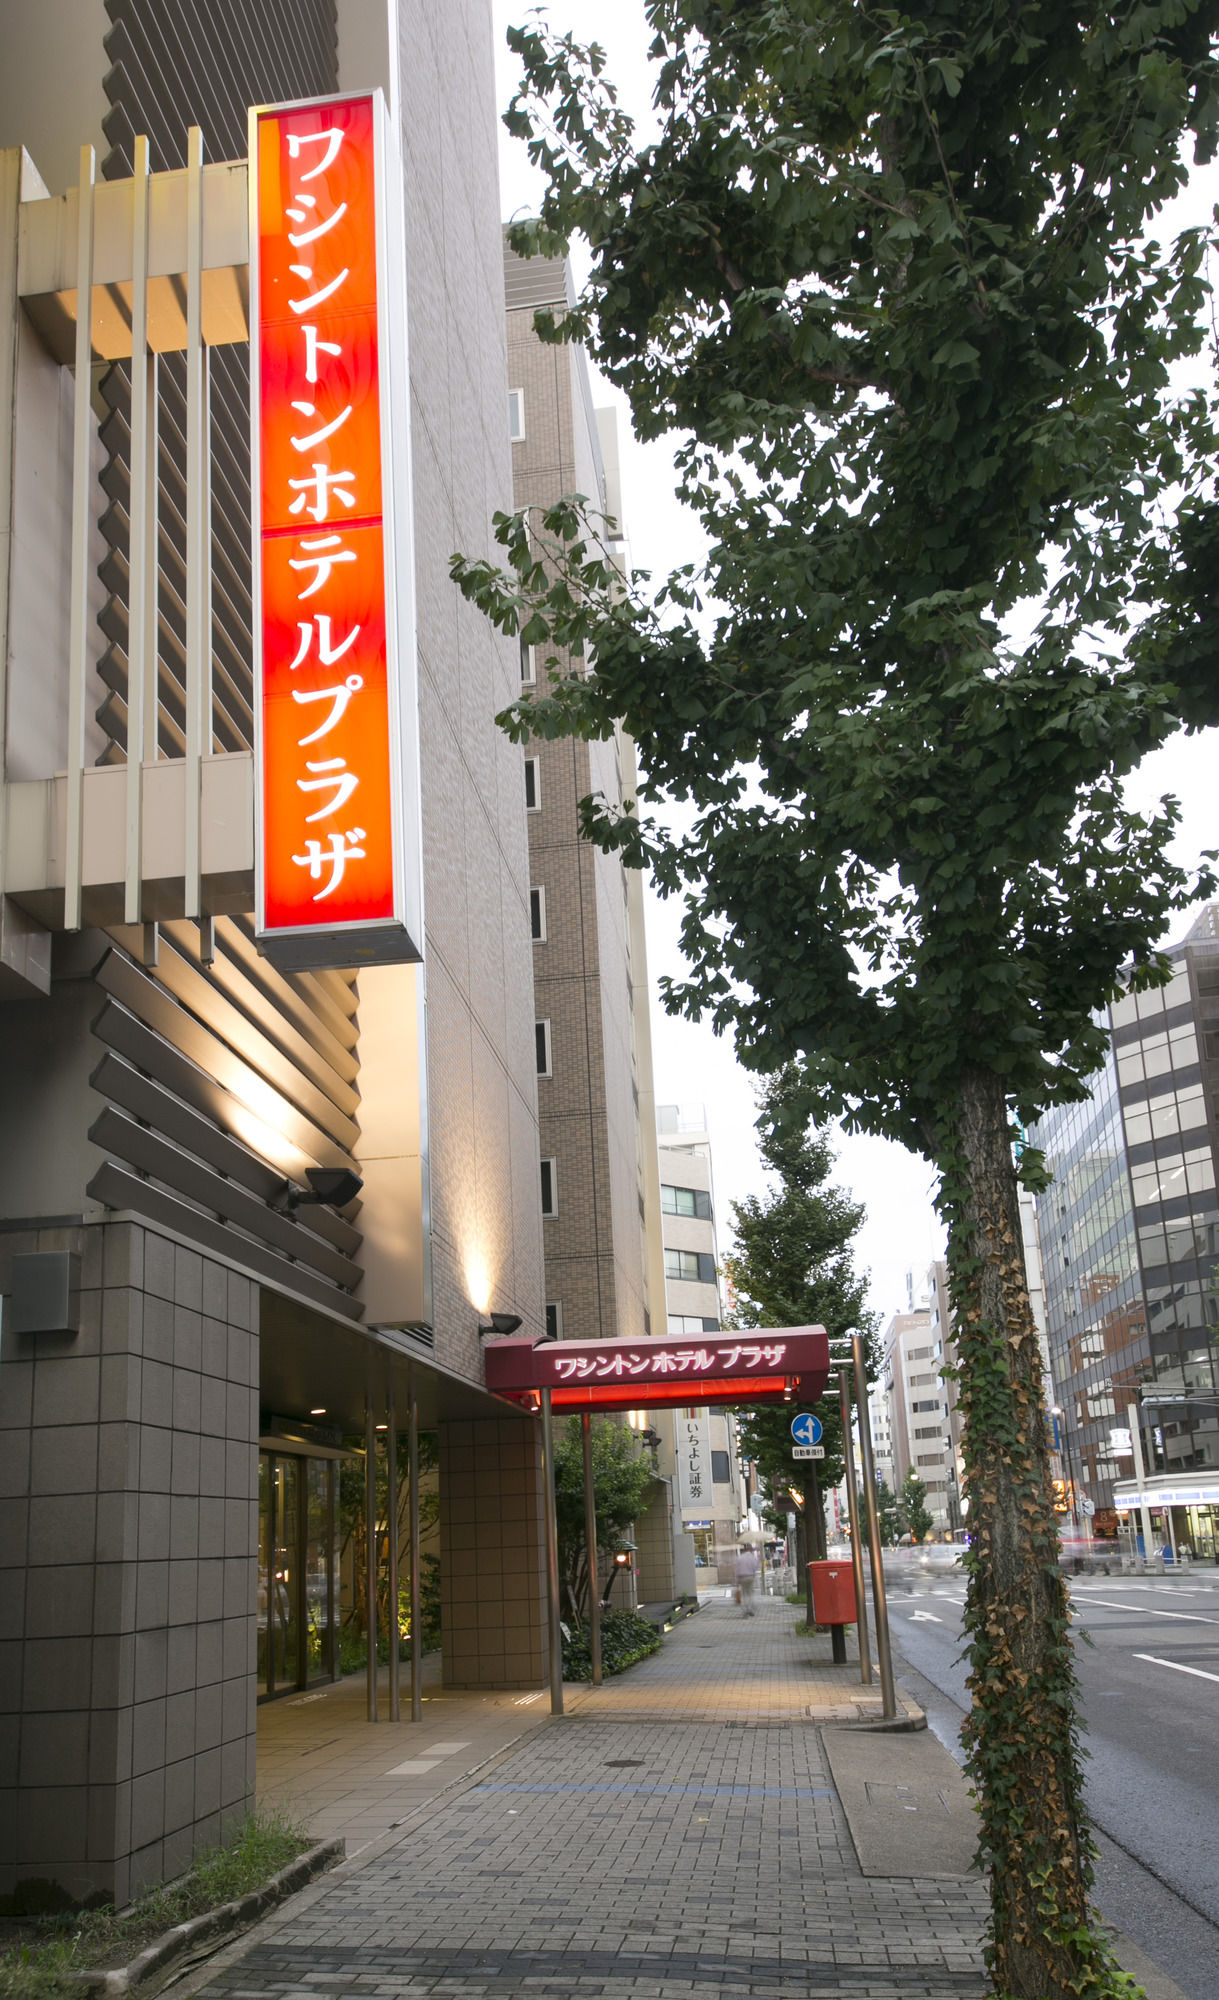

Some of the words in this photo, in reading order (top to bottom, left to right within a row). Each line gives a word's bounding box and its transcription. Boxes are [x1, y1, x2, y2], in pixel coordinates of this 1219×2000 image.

[285, 127, 367, 901] ワシントンホテルプラザ
[687, 1422, 703, 1498] いちよし証券
